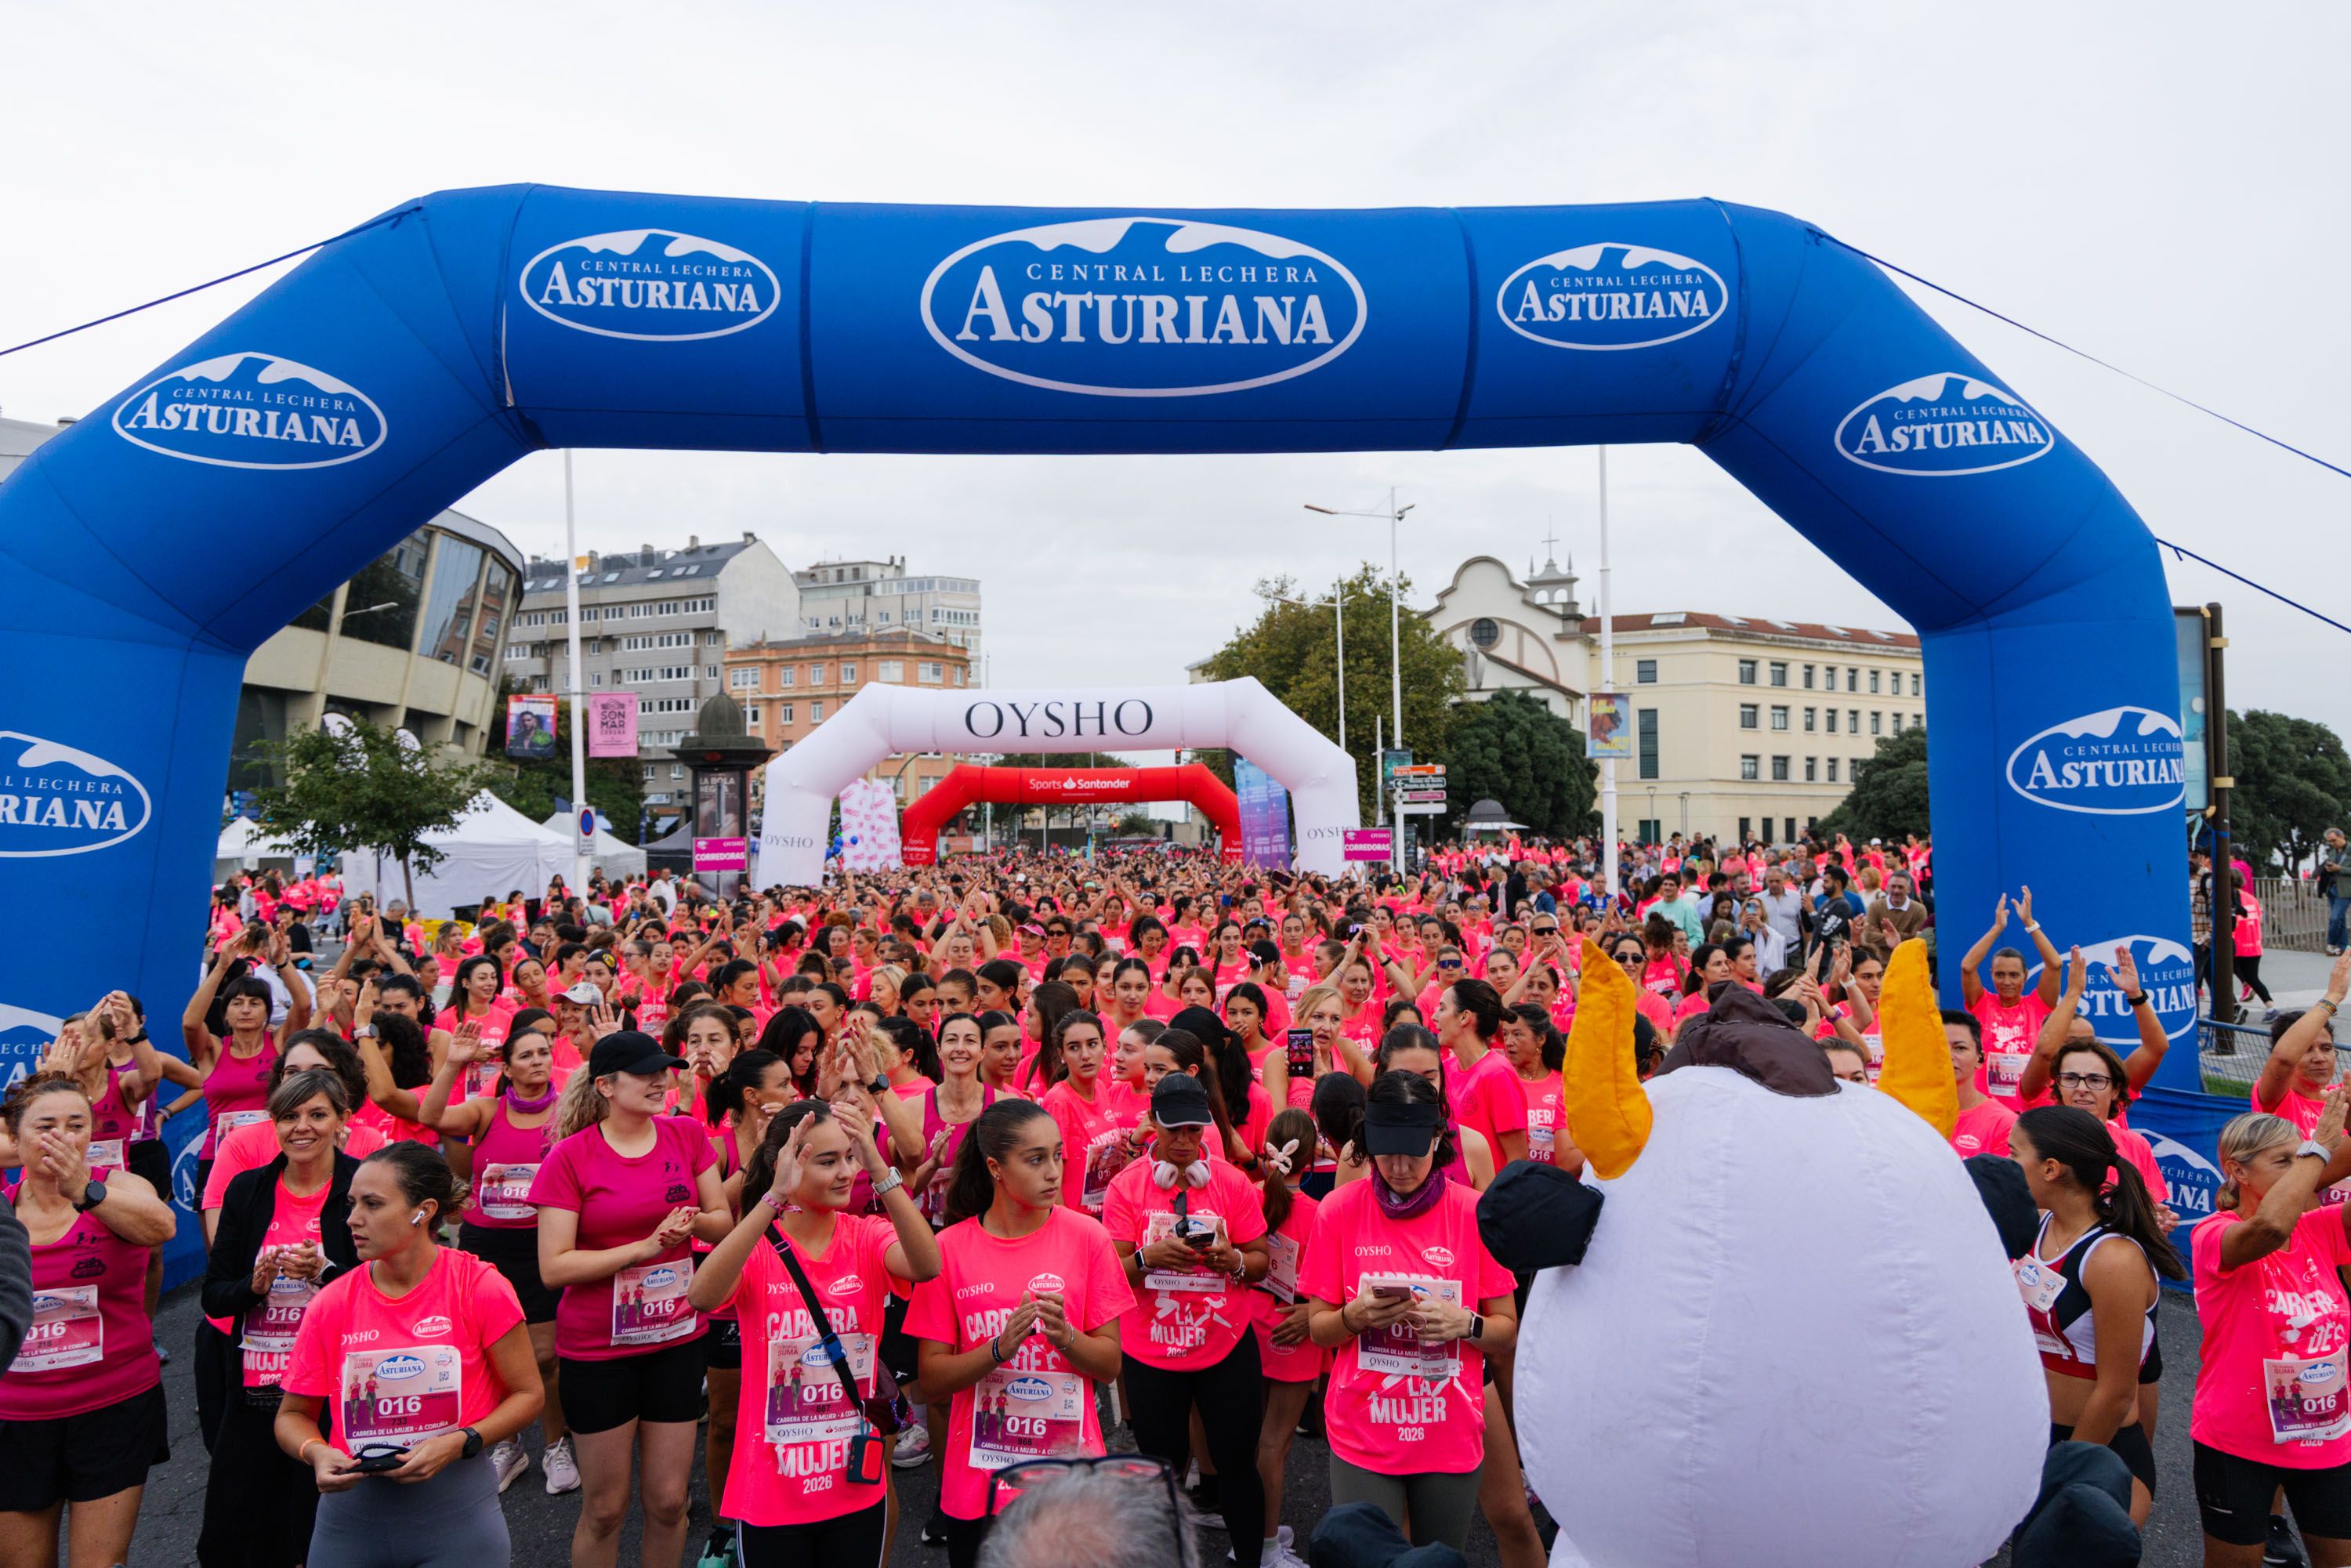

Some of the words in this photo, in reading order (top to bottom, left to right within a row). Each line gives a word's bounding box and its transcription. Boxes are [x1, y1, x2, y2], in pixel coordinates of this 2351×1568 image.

[581, 260, 662, 273] CENTRAL
[671, 264, 752, 277] LECHERA
[1027, 263, 1165, 281] CENTRAL
[1180, 265, 1318, 283] LECHERA
[539, 261, 761, 313] ASTURIANA
[1551, 277, 1623, 288] CENTRAL
[1631, 274, 1702, 286] LECHERA
[956, 266, 1334, 345] ASTURIANA
[1514, 280, 1711, 322] ASTURIANA
[173, 388, 254, 401] CENTRAL
[263, 393, 355, 412] LECHERA
[125, 392, 365, 447] ASTURIANA
[1894, 407, 1966, 420] CENTRAL
[1973, 406, 2030, 418] LECHERA
[1853, 415, 2046, 454] ASTURIANA
[601, 711, 625, 719] SON
[965, 700, 1154, 737] OYSHO
[2063, 744, 2138, 756] CENTRAL
[24, 777, 122, 795] LECHERA
[1029, 778, 1062, 791] Sports
[1078, 778, 1130, 789] Santander
[0, 795, 128, 830] RIANA
[765, 834, 813, 849] OYSHO
[695, 852, 745, 861] CORREDORAS
[2074, 982, 2196, 1016] STURIANA
[643, 1004, 666, 1012] RRERA
[2000, 1073, 2020, 1081] 016
[1529, 1150, 1550, 1161] 016
[2161, 1165, 2210, 1184] ECHERA
[503, 1187, 529, 1197] 016
[2330, 1190, 2351, 1203] 01
[1355, 1245, 1391, 1256] OYSHO
[645, 1276, 675, 1286] ASTURIANA
[957, 1283, 994, 1299] OYSHO
[266, 1307, 301, 1321] 016
[644, 1299, 675, 1316] 016
[26, 1321, 67, 1341] 016
[416, 1324, 451, 1333] ASTURIANA
[1150, 1323, 1206, 1347] MUJER
[1391, 1323, 1413, 1338] 01
[56, 1353, 89, 1363] Santander
[244, 1351, 290, 1371] MUJE
[1370, 1357, 1399, 1367] OYSHO
[379, 1365, 422, 1374] ASTURIANA
[2302, 1369, 2335, 1380] ASTURIANA
[802, 1383, 843, 1403] 016
[1009, 1385, 1049, 1396] ASTURIANA
[379, 1396, 422, 1415] 016
[1370, 1396, 1446, 1425] MUJER
[2303, 1395, 2337, 1412] 016
[392, 1417, 407, 1426] 733
[425, 1421, 448, 1430] CORUÑA
[1006, 1416, 1046, 1436] 016
[777, 1428, 813, 1437] OYSHO
[1398, 1427, 1424, 1442] 2026
[982, 1454, 1014, 1464] OYSHO
[803, 1474, 832, 1494] 2026
